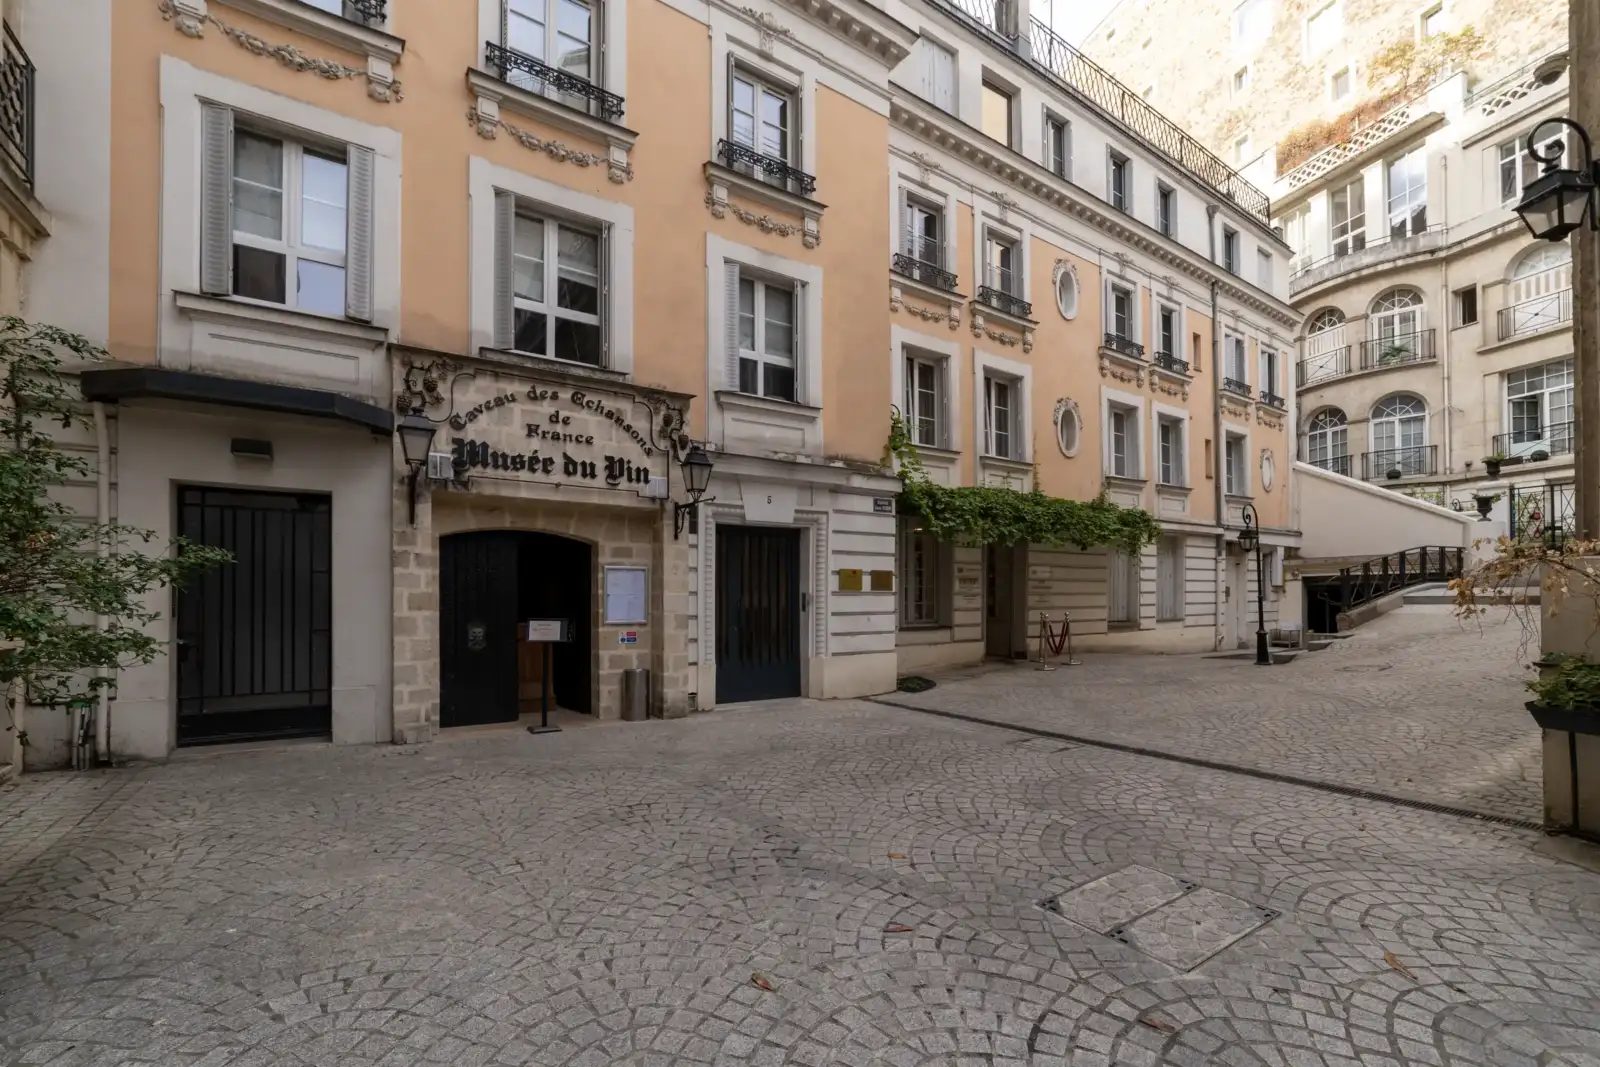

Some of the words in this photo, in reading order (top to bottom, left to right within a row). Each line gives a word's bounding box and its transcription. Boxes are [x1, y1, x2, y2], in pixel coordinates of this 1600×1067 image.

[449, 391, 517, 431] Caveau
[526, 384, 559, 401] des
[570, 390, 654, 457] Echansons
[549, 410, 571, 426] de
[525, 423, 594, 446] France
[451, 436, 555, 475] Musée
[563, 452, 598, 480] du
[604, 454, 651, 486] Vin
[766, 496, 772, 505] 5
